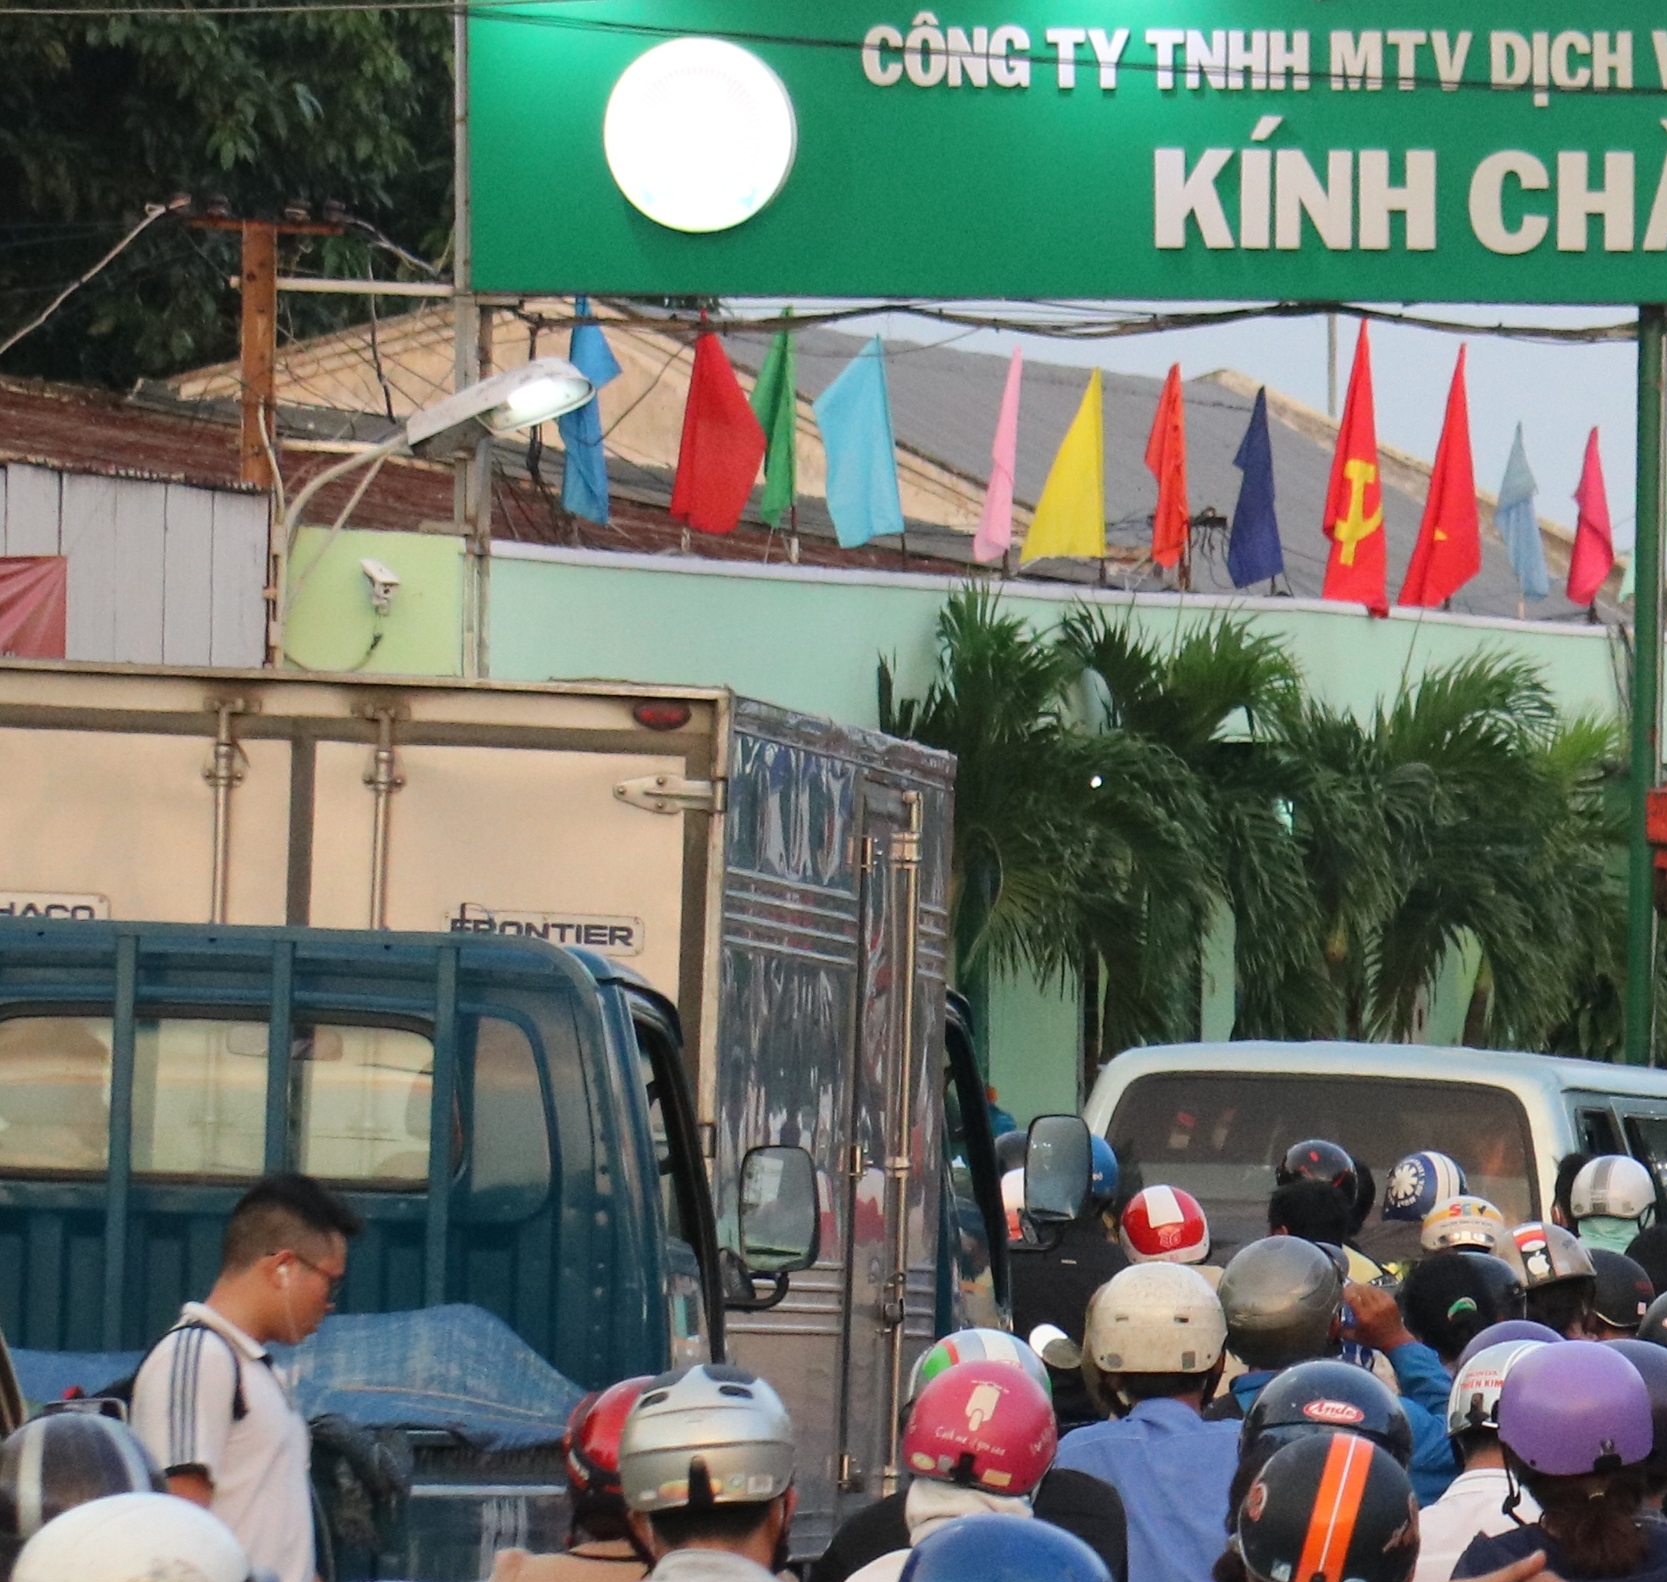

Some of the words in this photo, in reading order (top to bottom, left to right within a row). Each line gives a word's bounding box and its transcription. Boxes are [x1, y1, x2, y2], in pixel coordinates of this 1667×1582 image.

[862, 11, 1030, 88] CÔNG
[1046, 29, 1124, 90] TY
[1146, 30, 1310, 90] TNHH
[1330, 30, 1472, 90] MTV
[1491, 31, 1632, 106] DỊCH
[1154, 116, 1436, 250] KÍNH
